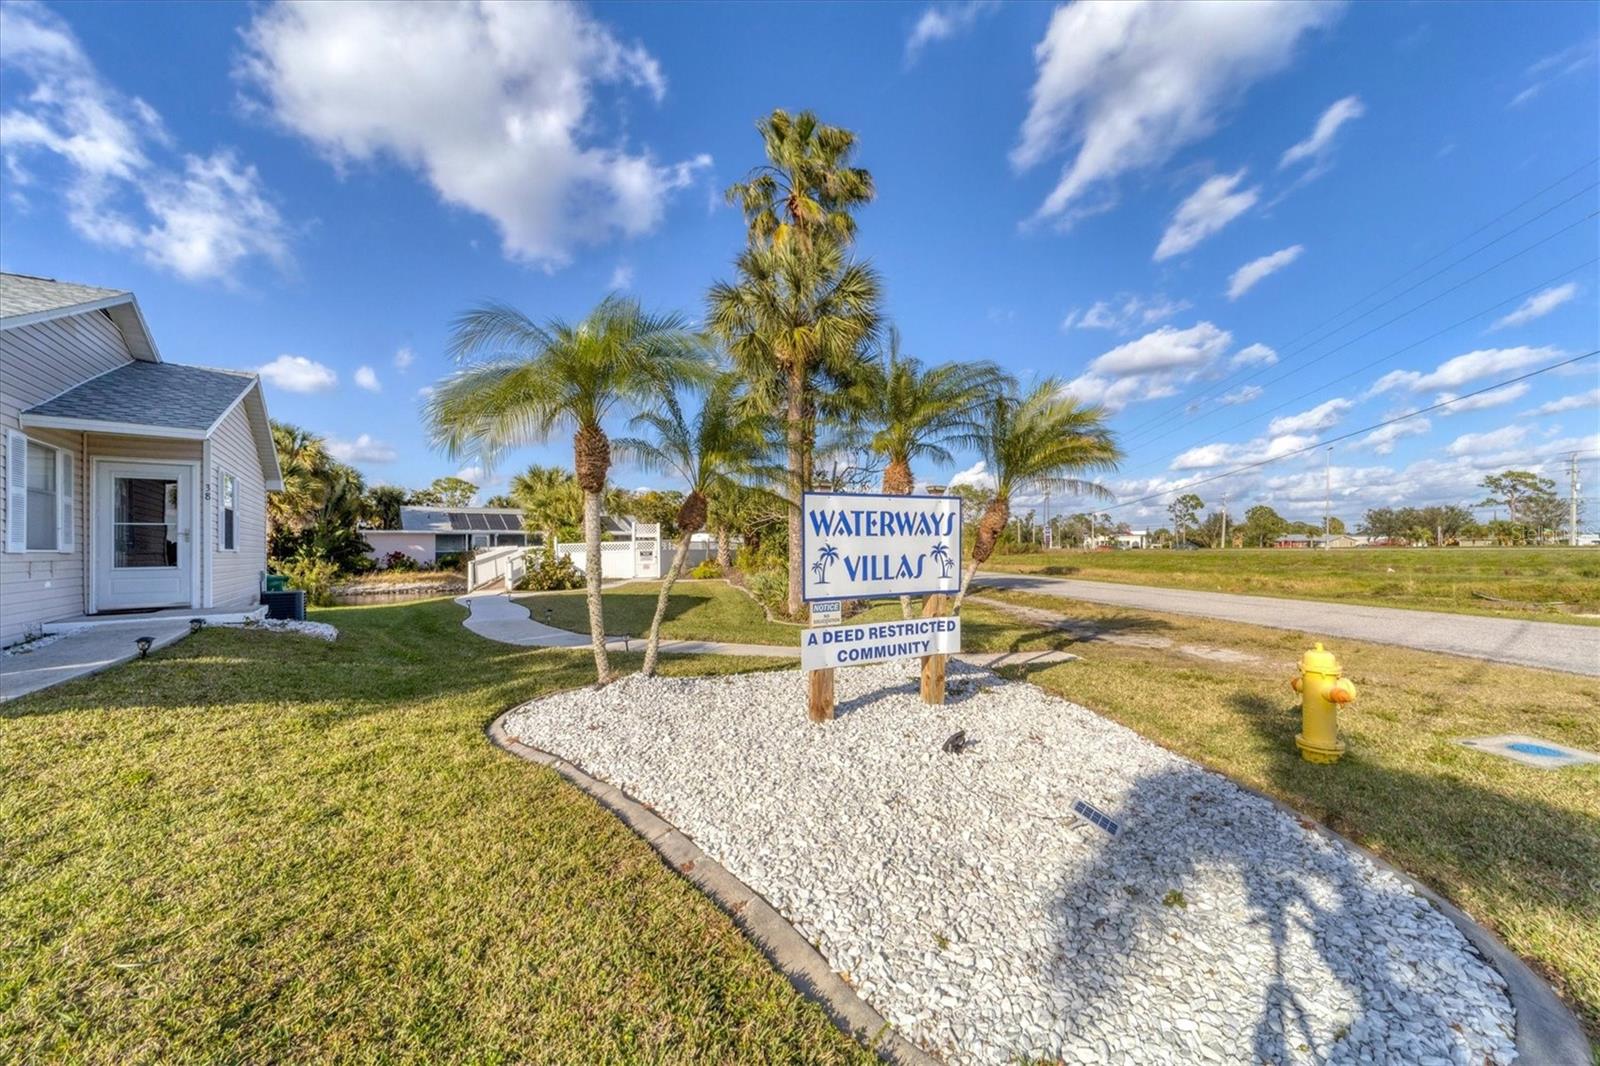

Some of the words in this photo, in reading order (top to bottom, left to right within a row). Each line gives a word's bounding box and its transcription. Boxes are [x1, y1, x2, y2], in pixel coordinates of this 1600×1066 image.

[809, 509, 956, 537] WATERWAYS
[843, 553, 926, 582] VILLAS
[813, 603, 839, 612] NOTICE
[808, 633, 818, 646] A
[823, 629, 865, 645] DEED
[869, 621, 956, 640] RESTRICTED
[837, 641, 930, 662] COMMUNITY
